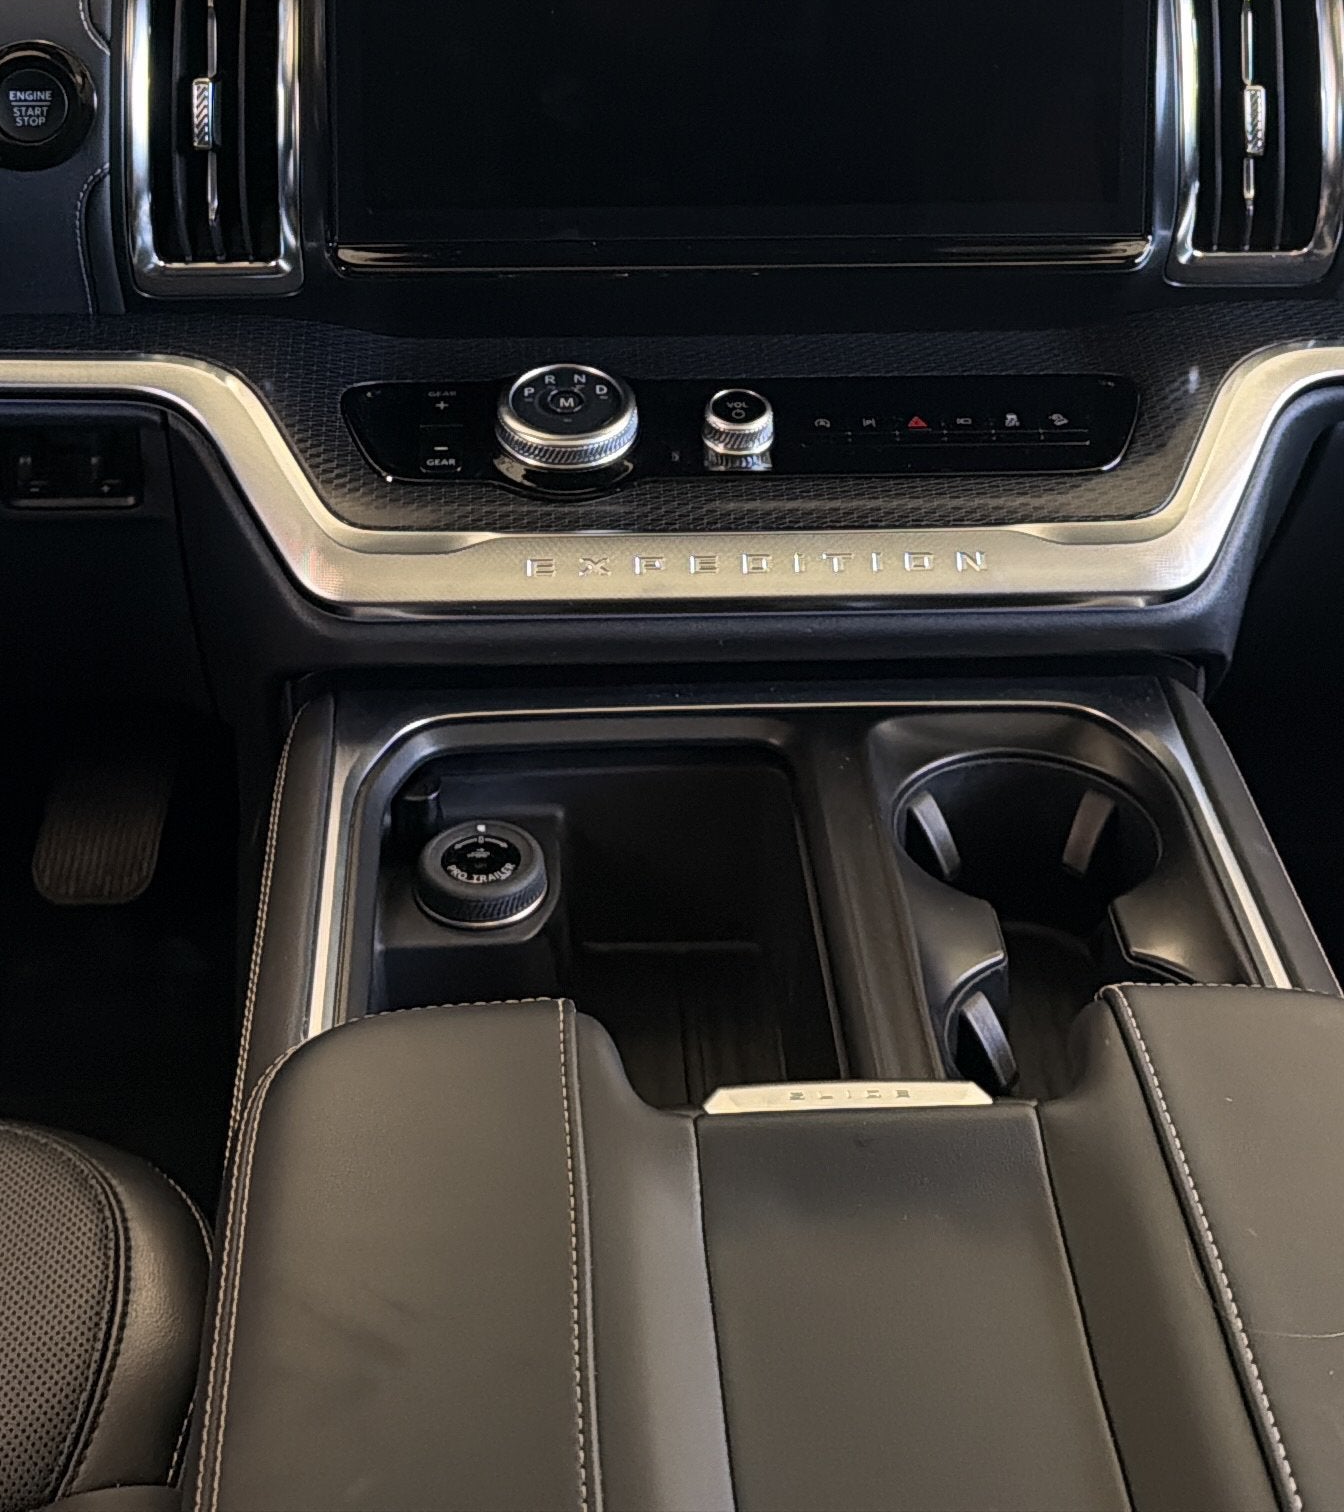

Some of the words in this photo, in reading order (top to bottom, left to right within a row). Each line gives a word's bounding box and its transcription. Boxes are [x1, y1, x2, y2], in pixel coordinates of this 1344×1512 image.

[9, 90, 52, 101] ENGINE
[13, 107, 49, 117] START
[16, 117, 46, 127] STOP
[544, 374, 555, 385] R
[574, 373, 586, 384] N
[523, 387, 536, 398] P
[559, 397, 574, 408] M
[596, 384, 608, 395] D
[726, 401, 748, 409] VOL
[426, 458, 456, 466] GEAR
[525, 550, 986, 577] EXPEDITION
[447, 864, 468, 880] PRO
[472, 862, 516, 883] TRAILER
